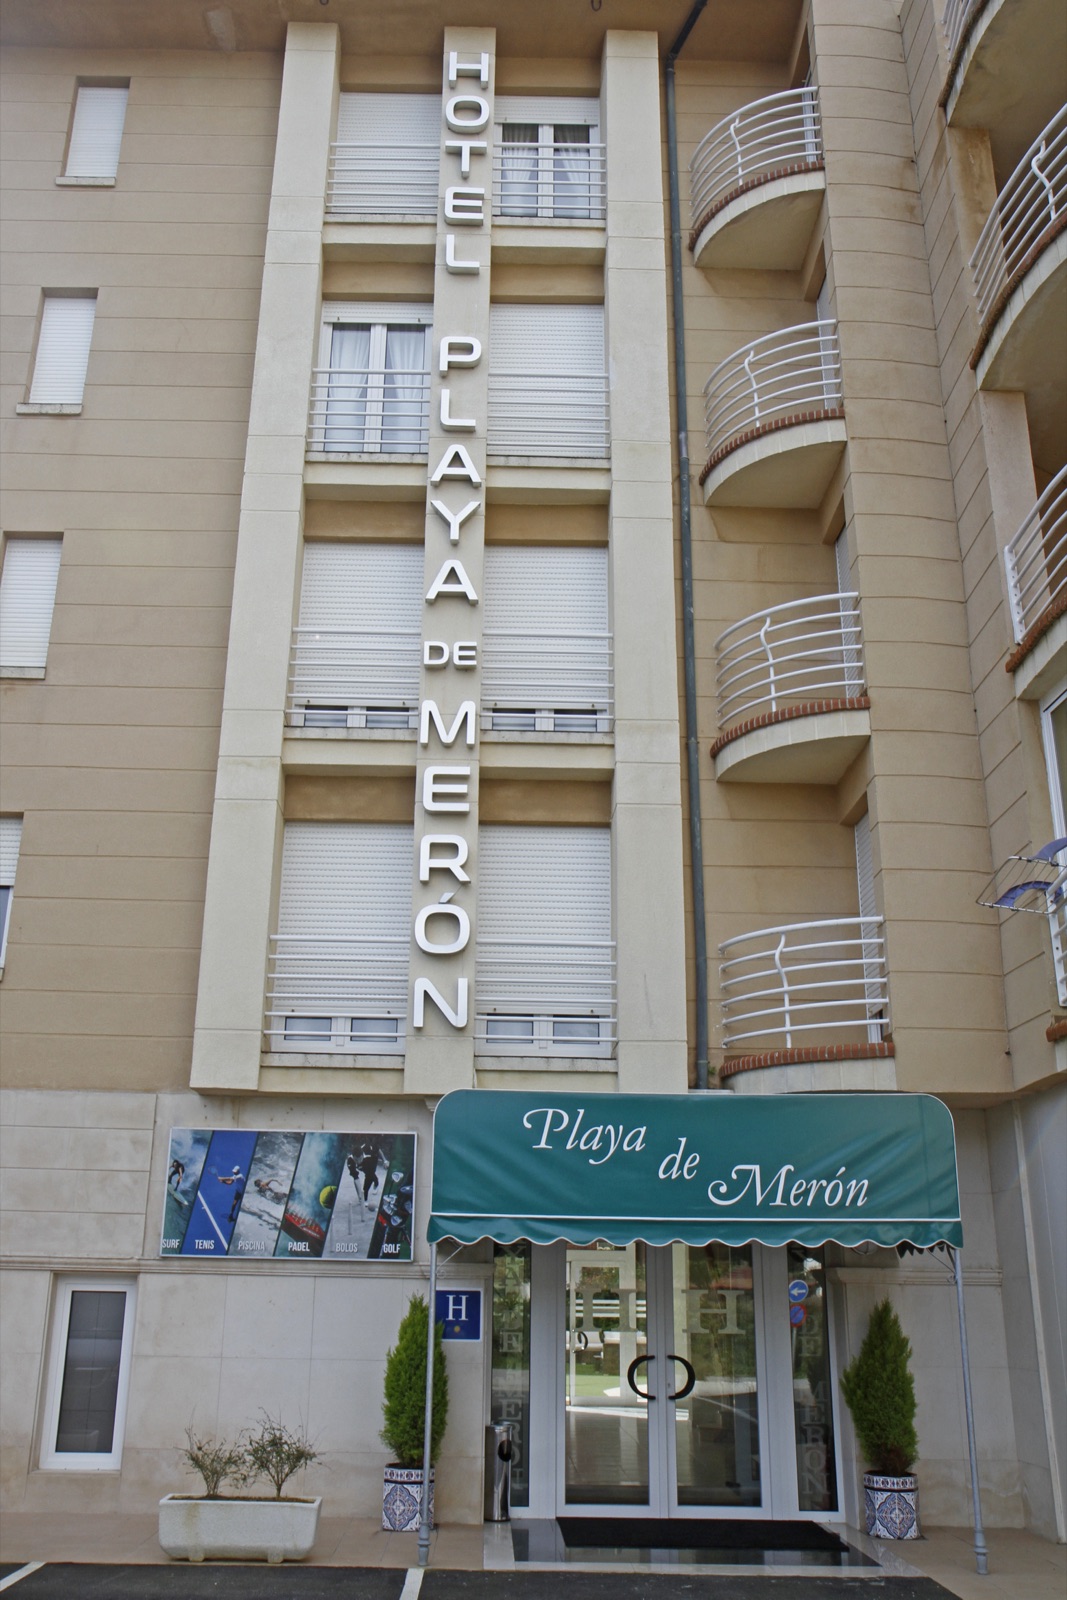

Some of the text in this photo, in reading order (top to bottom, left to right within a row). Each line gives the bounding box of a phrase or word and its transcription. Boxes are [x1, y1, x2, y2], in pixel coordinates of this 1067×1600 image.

[413, 52, 490, 1028] HOTEL PLAYA DE MERÓN
[523, 1108, 869, 1207] Playa de Merón
[162, 1239, 180, 1249] SURF
[195, 1239, 215, 1250] TENIS
[238, 1240, 265, 1250] PISCINA
[287, 1241, 310, 1252] PADEL
[335, 1243, 358, 1253] BOLOS
[383, 1243, 401, 1253] GOLF
[446, 1294, 469, 1321] H
[681, 1289, 746, 1334] H
